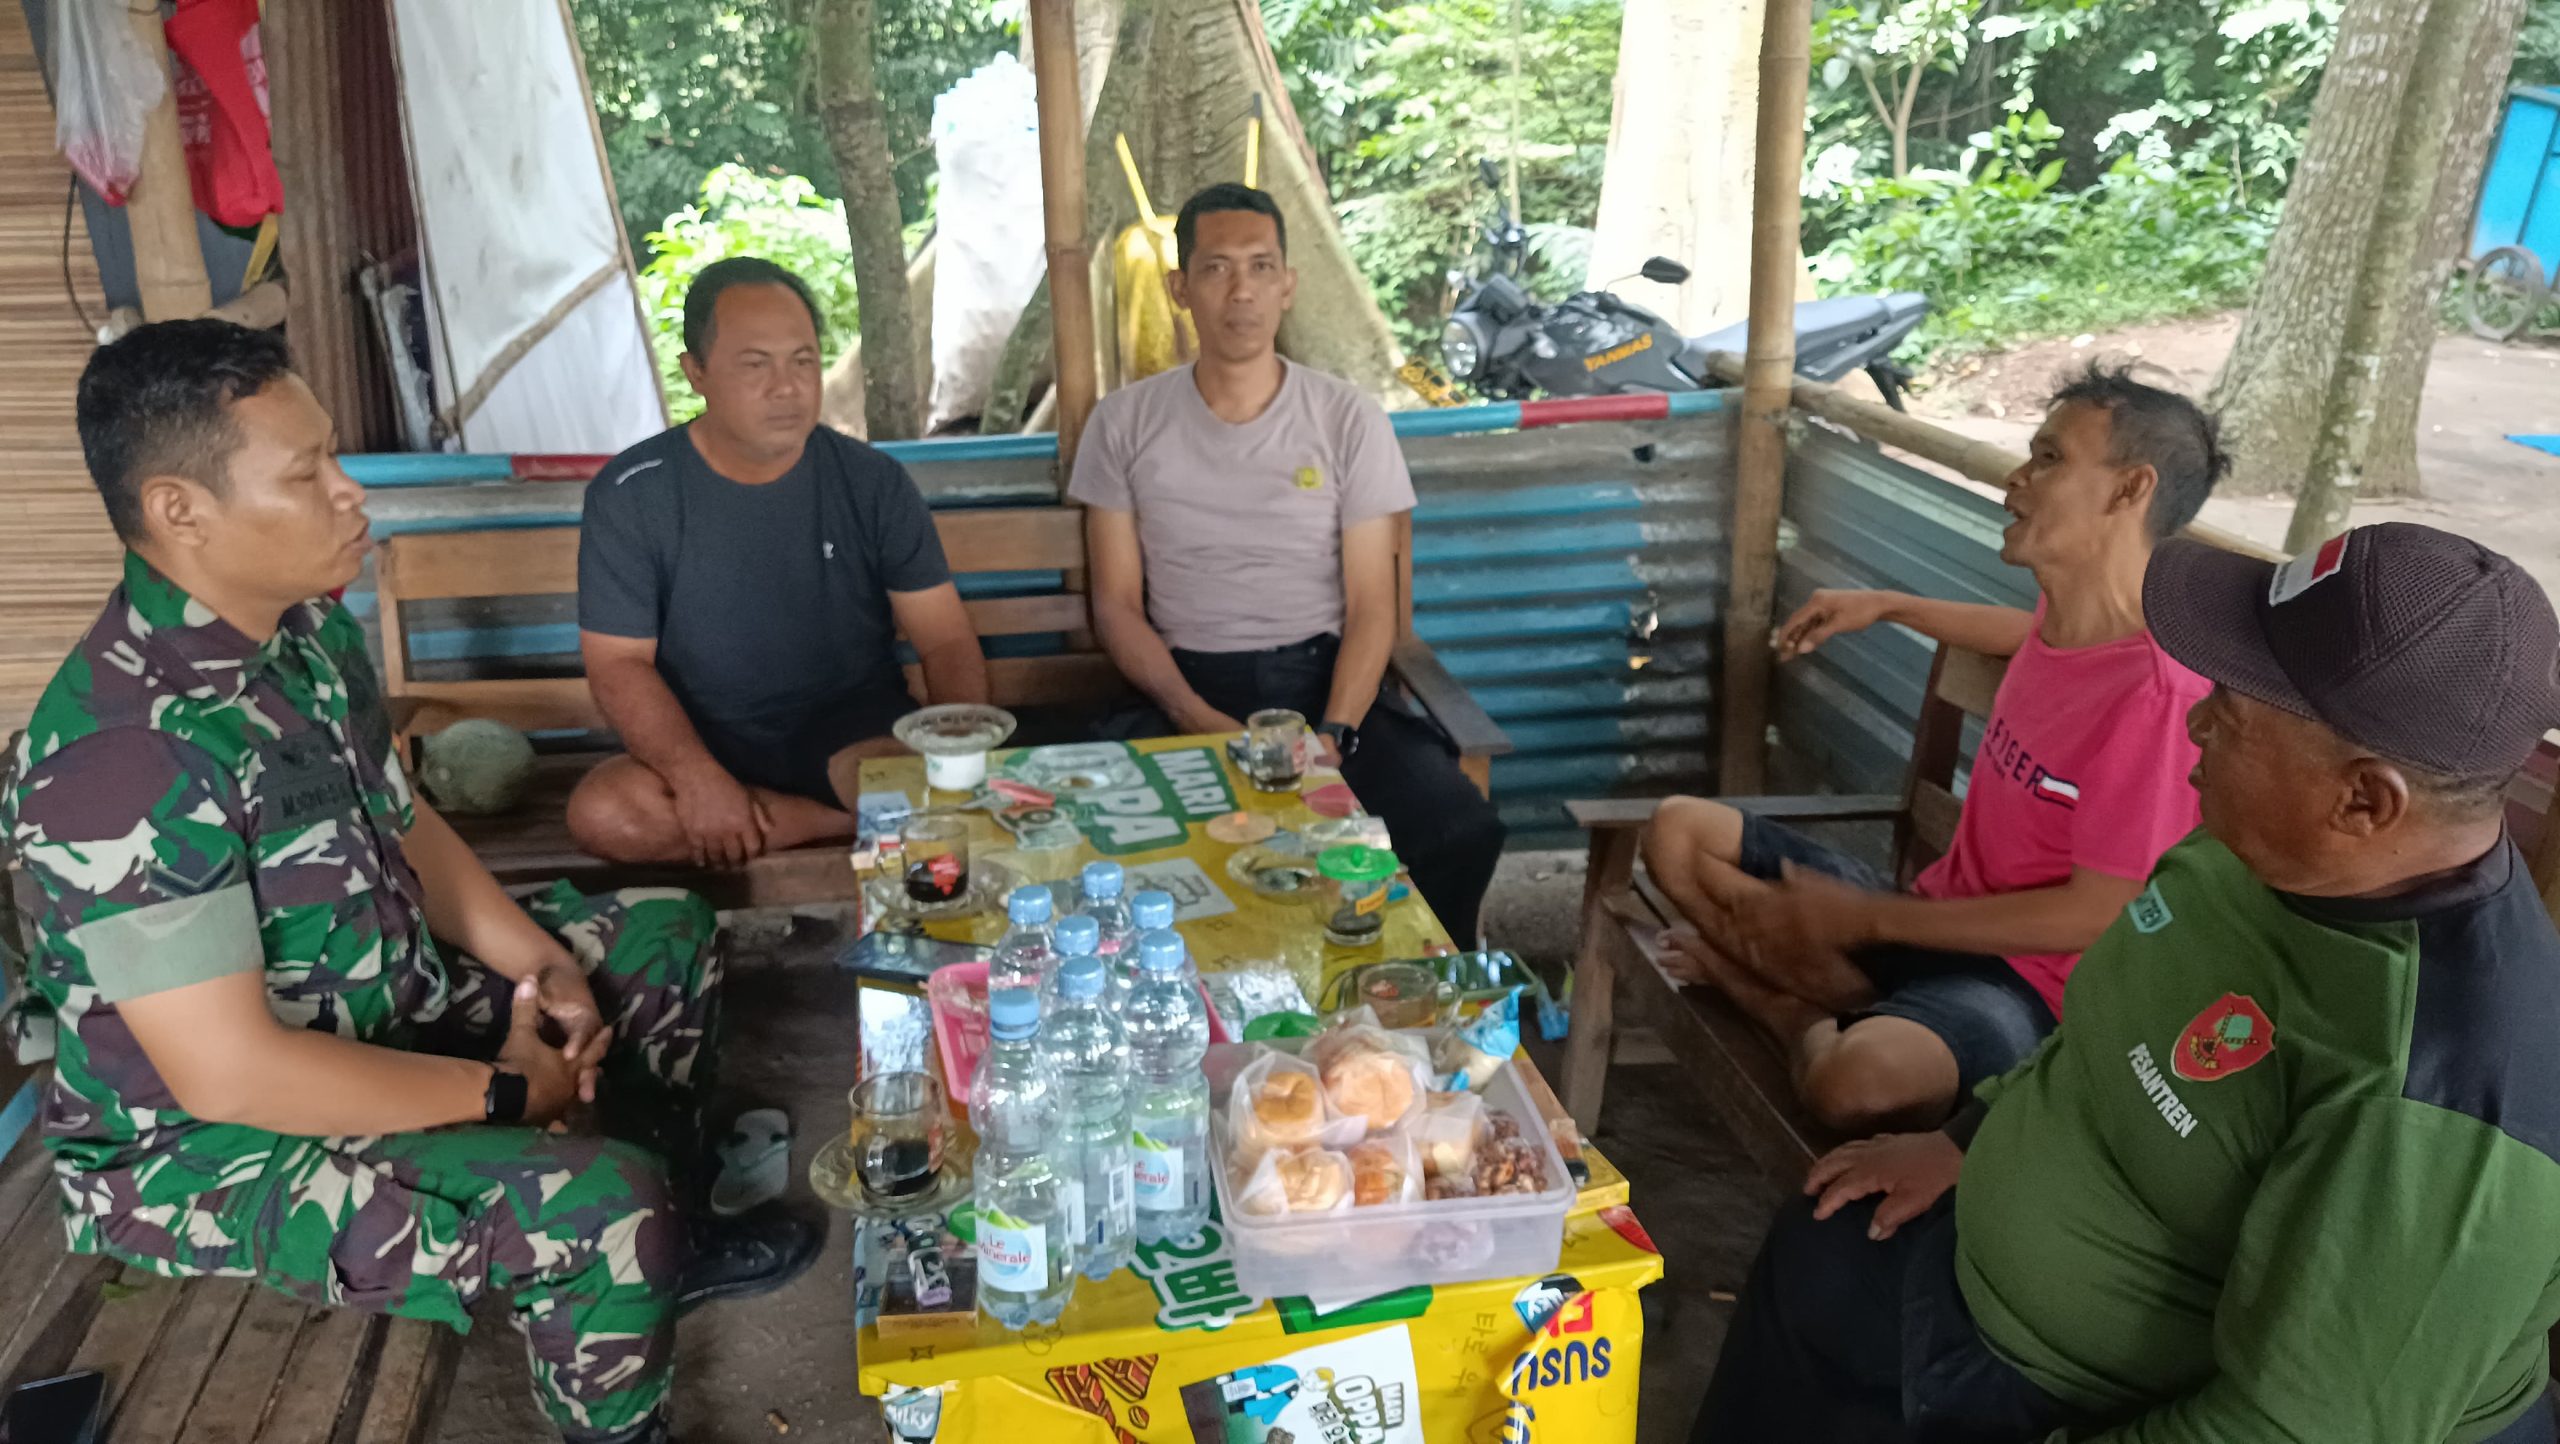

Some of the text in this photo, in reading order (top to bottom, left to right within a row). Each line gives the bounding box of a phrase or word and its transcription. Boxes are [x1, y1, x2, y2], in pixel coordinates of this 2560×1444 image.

[1152, 748, 1233, 816] MARI
[1987, 717, 2045, 794] FIGER
[2127, 1041, 2199, 1139] PESANTREN
[1511, 1337, 1612, 1397] SUSU
[1334, 1377, 1384, 1444] OPPA
